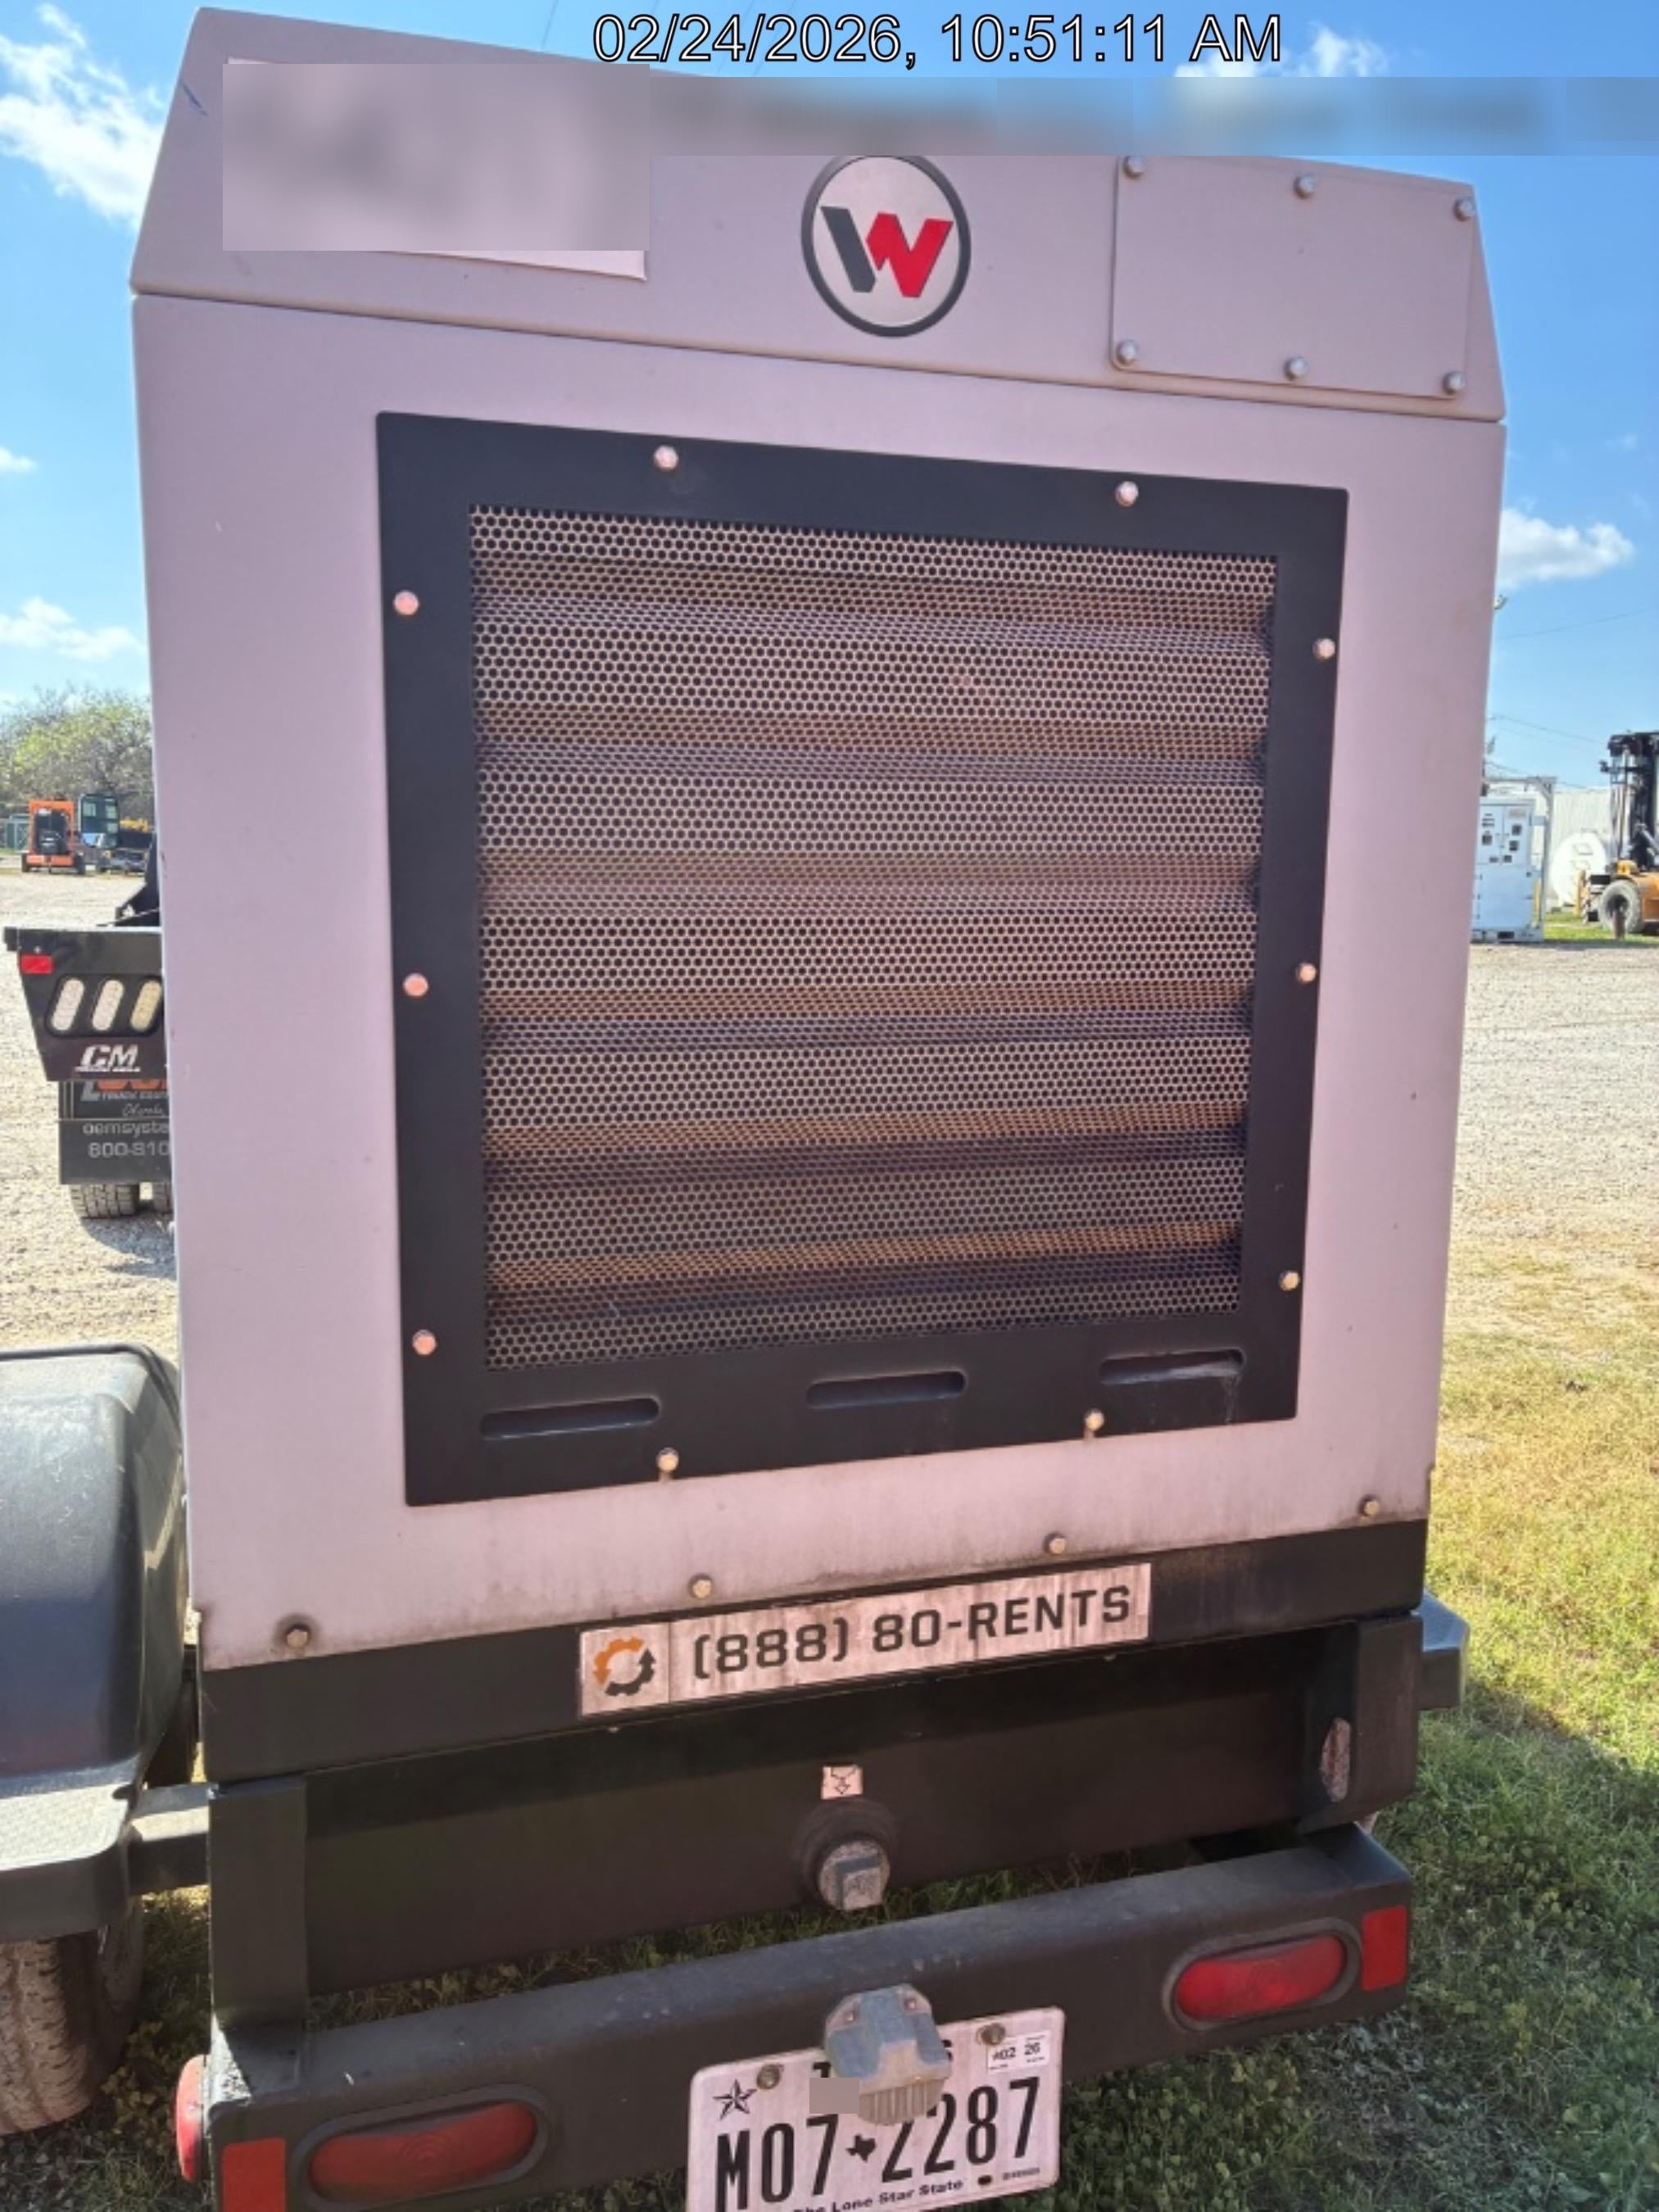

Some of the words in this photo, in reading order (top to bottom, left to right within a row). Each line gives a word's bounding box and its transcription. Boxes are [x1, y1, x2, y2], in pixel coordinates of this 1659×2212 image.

[693, 1618, 850, 1679] (888)
[872, 1584, 1131, 1653] 80-RENTS
[714, 2114, 840, 2212] M07
[879, 2189, 915, 2204] Star
[918, 2180, 963, 2195] State
